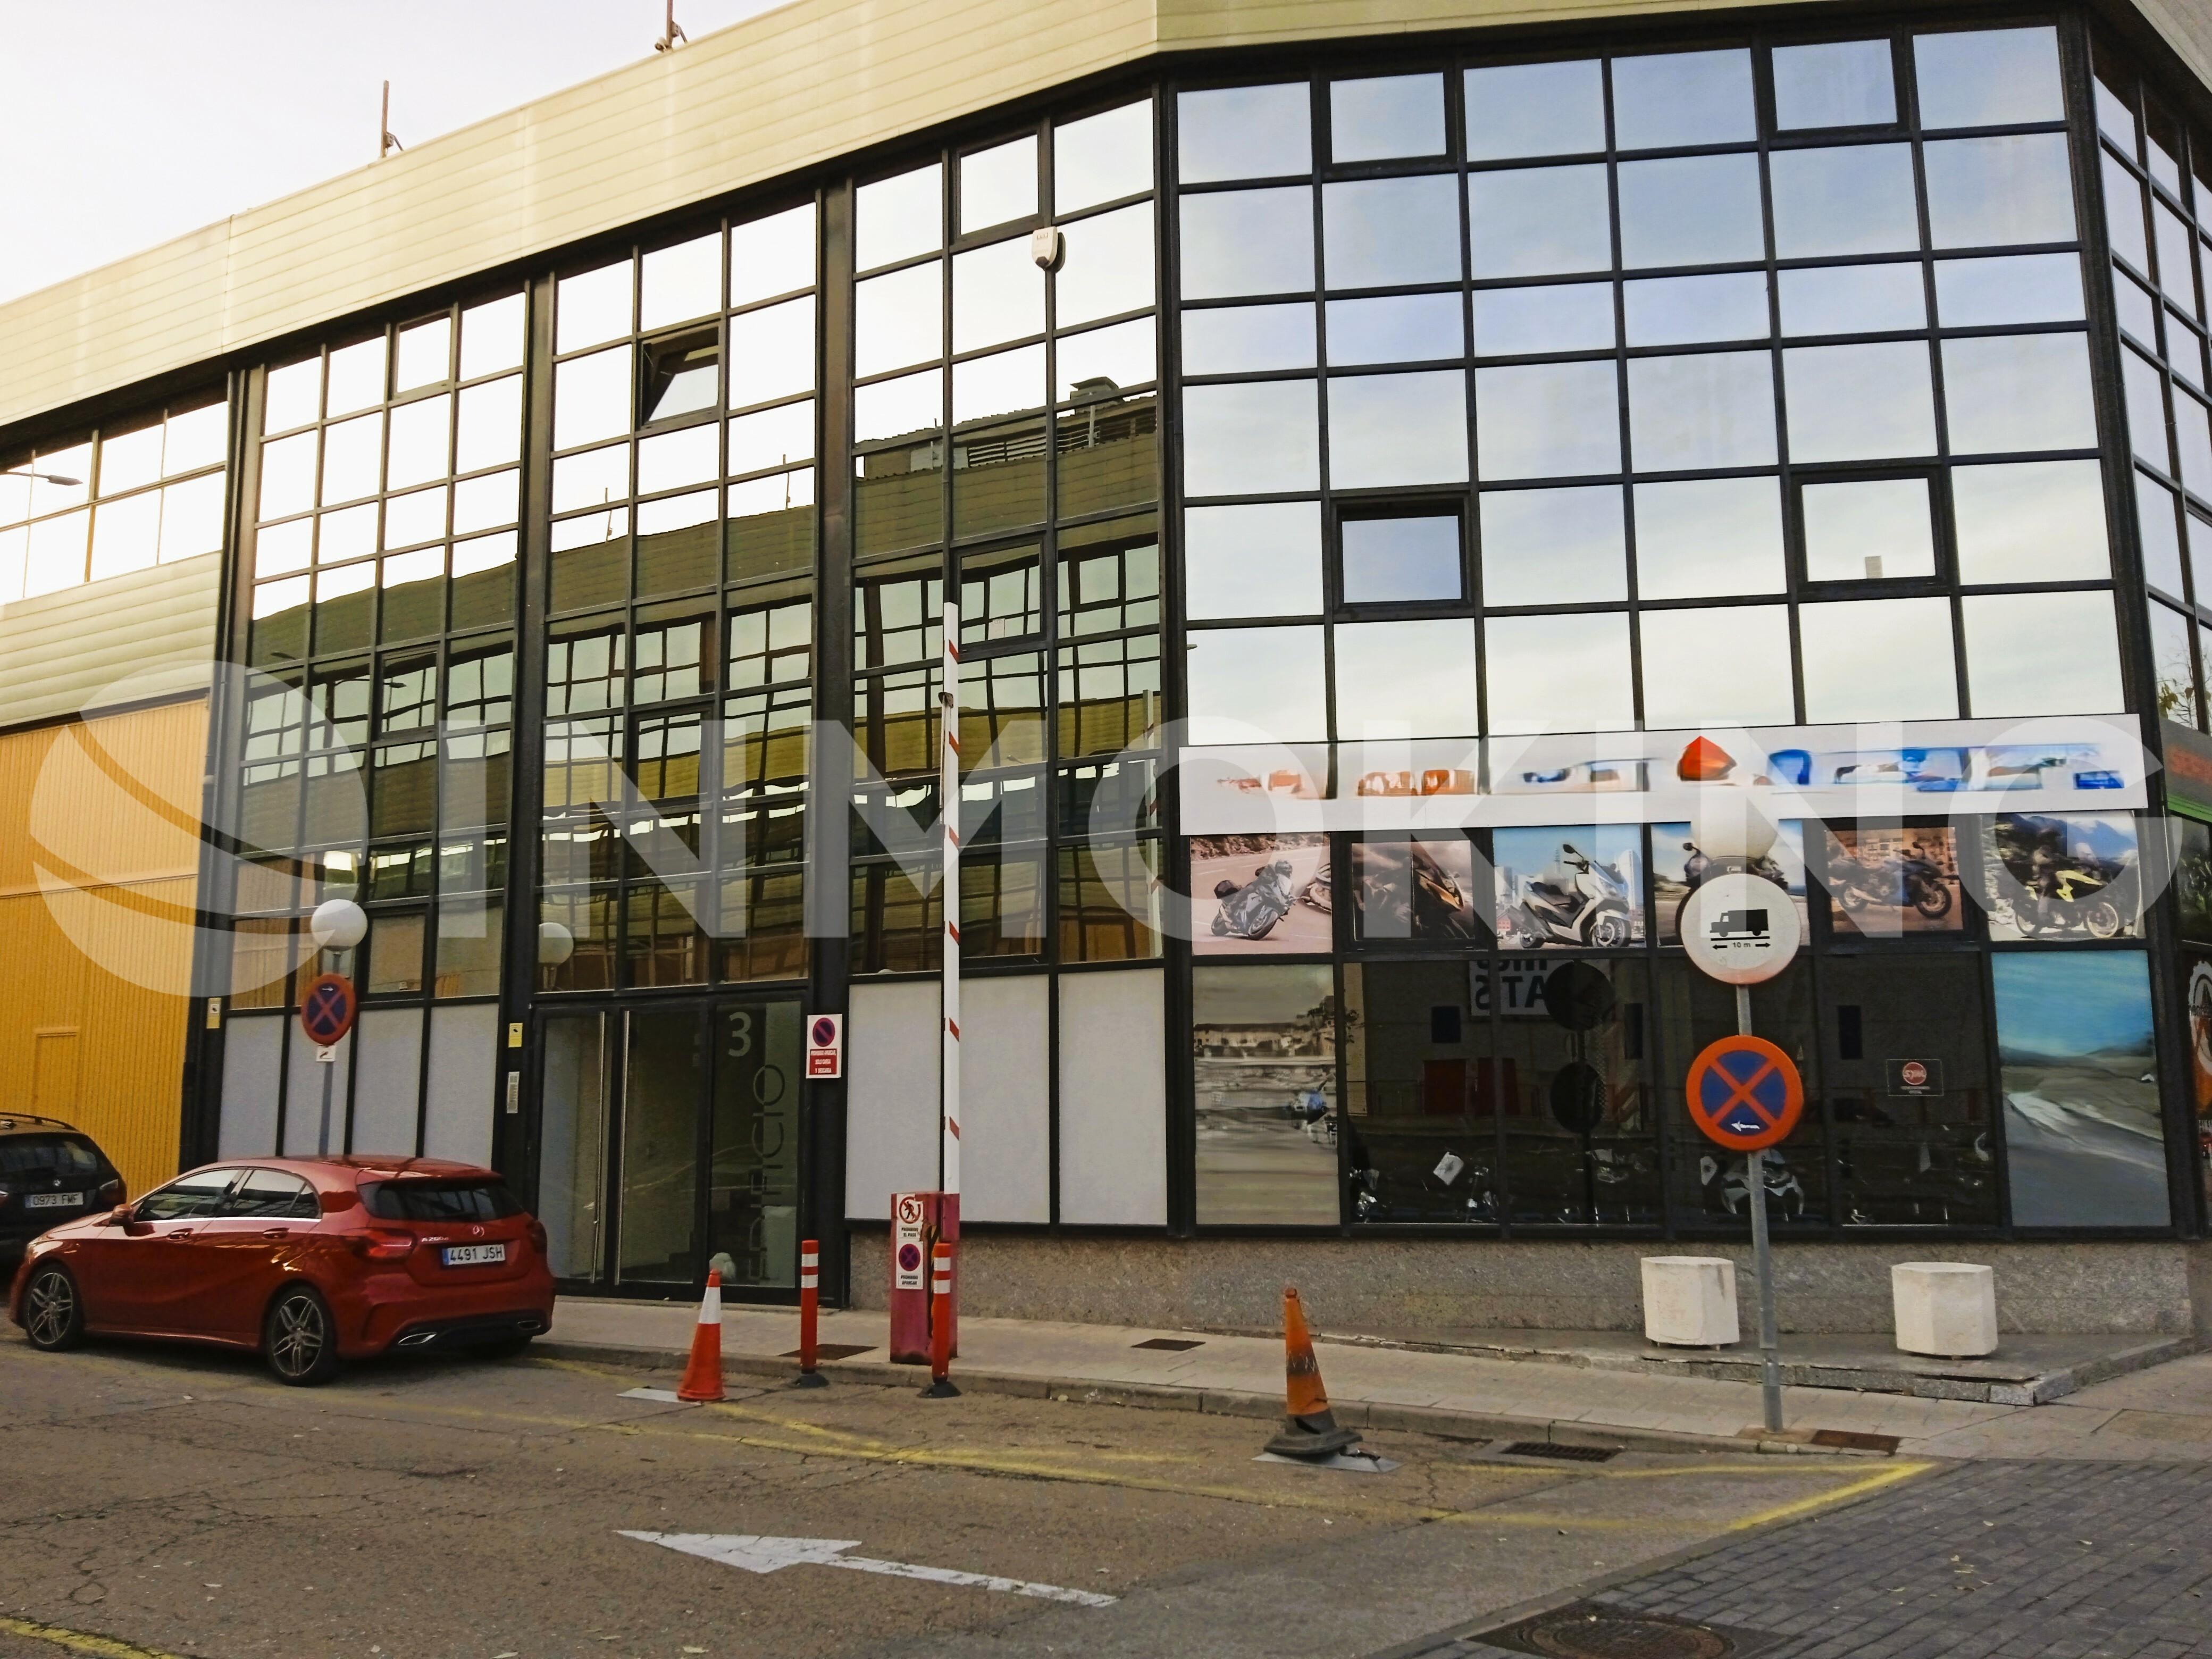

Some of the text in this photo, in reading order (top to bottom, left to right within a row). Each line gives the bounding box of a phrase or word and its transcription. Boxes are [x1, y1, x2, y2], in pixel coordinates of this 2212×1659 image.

[728, 1011, 751, 1057] 3
[33, 1195, 57, 1205] 0973
[450, 1246, 502, 1261] 4491 JSH
